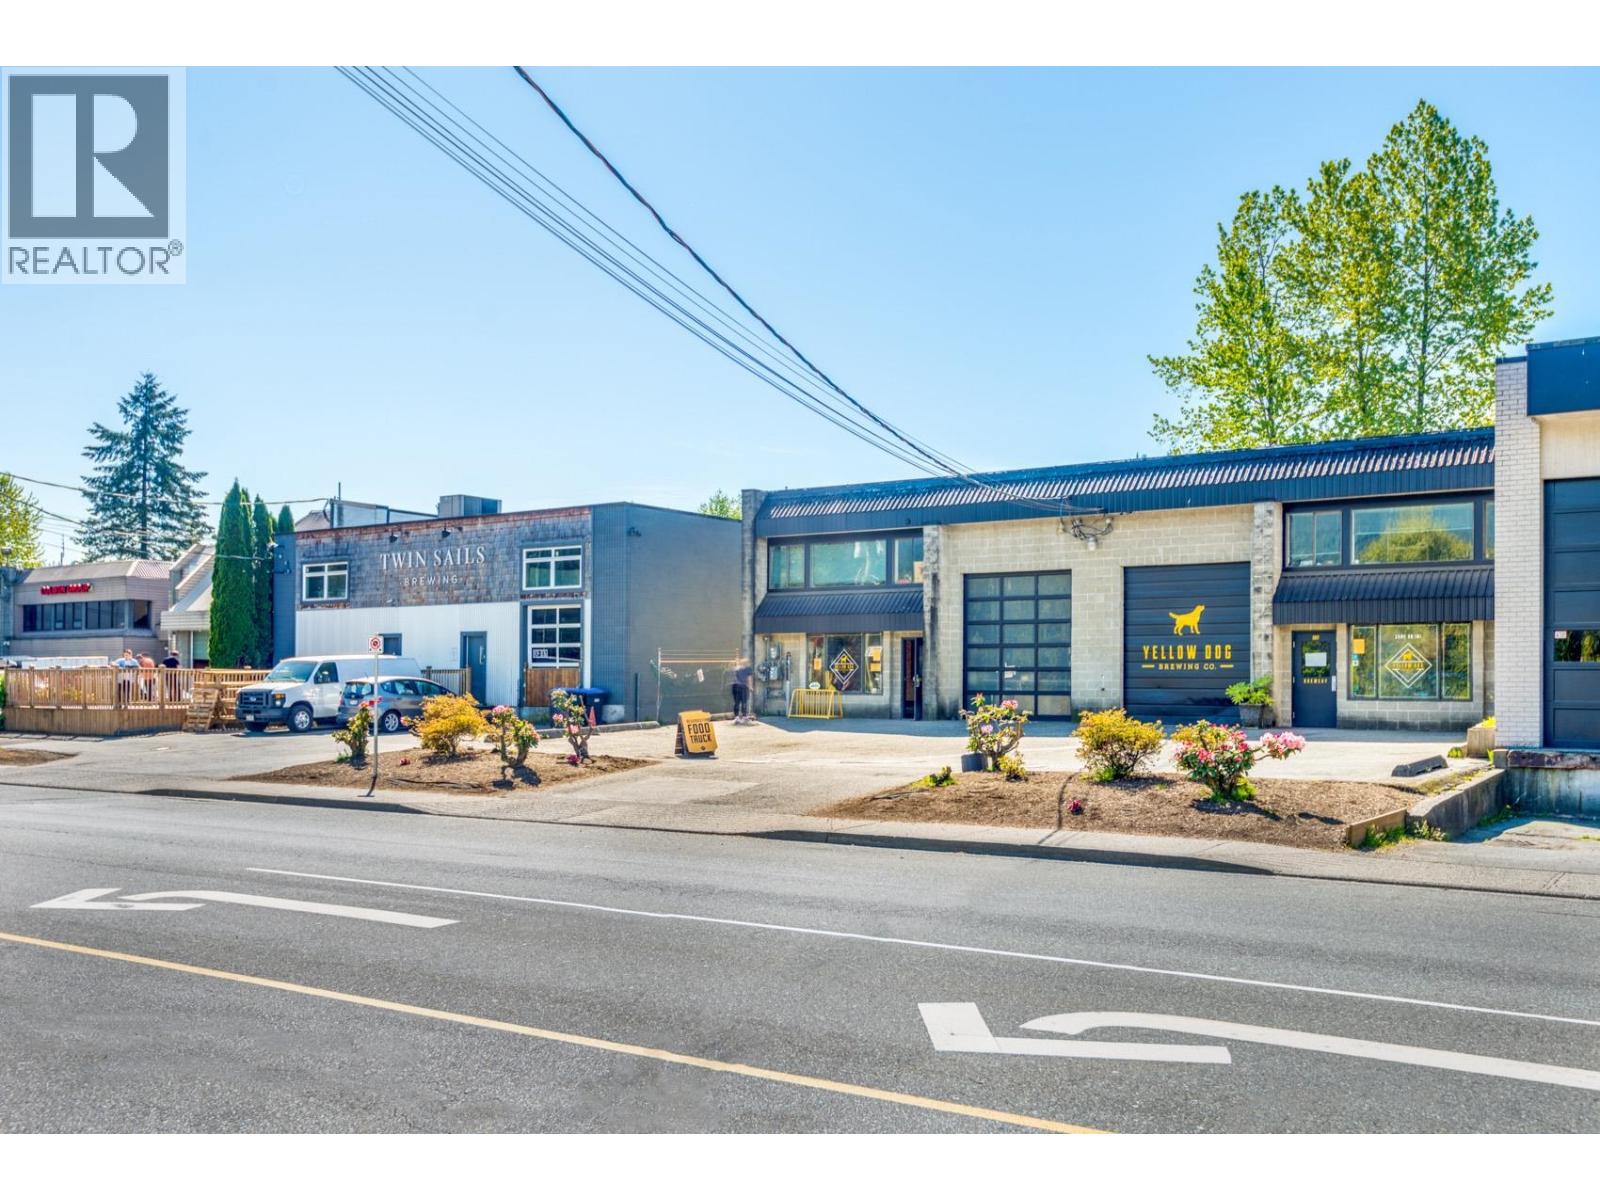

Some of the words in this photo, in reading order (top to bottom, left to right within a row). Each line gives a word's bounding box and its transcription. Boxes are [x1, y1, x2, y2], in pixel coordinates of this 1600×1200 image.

[380, 550, 427, 570] TWIN
[433, 545, 486, 567] SAILS
[403, 574, 458, 586] BREWING
[1142, 644, 1197, 660] YELLOW
[1204, 643, 1232, 660] DOG
[1158, 663, 1200, 671] BREWING
[1203, 663, 1217, 671] CO.
[687, 722, 711, 735] FOOD
[690, 734, 713, 744] TRUCK
